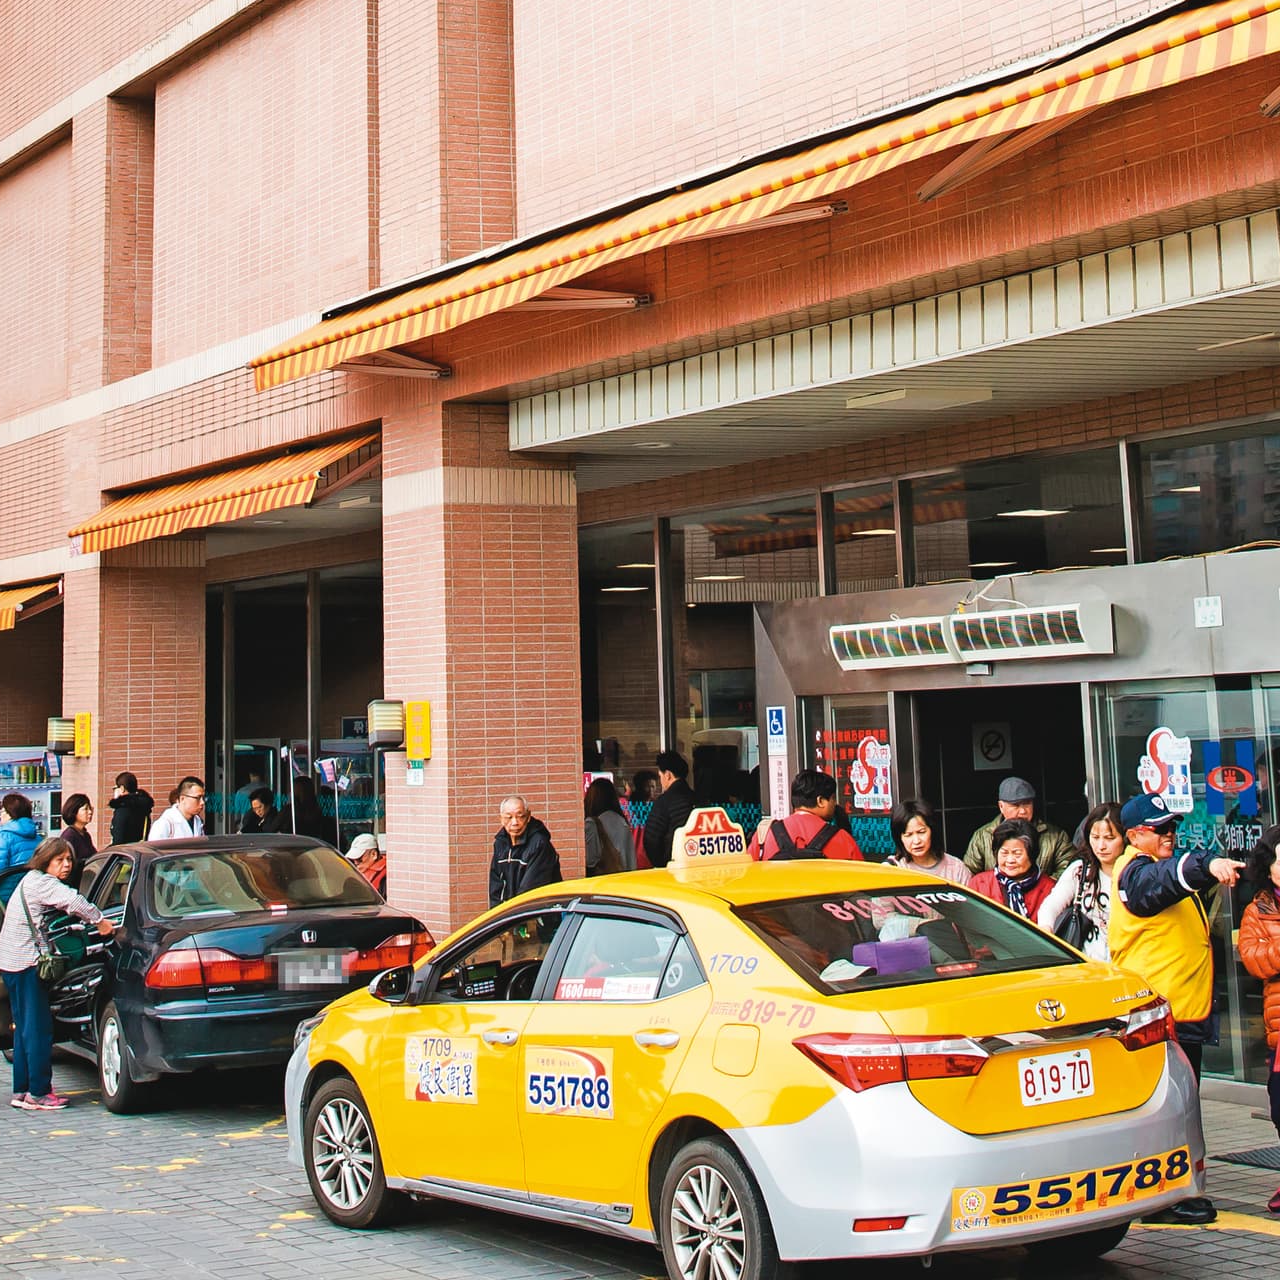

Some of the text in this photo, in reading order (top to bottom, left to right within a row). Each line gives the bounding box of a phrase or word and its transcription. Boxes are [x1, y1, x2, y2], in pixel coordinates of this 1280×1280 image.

[698, 834, 744, 856] 551788
[822, 891, 968, 922] 819-7D 1709
[708, 953, 759, 976] 1709
[560, 983, 584, 1000] 1600
[738, 998, 816, 1030] 819-7D
[422, 1038, 452, 1057] 1709
[419, 1060, 474, 1097] 優良衛星
[528, 1074, 612, 1110] 551788
[991, 1149, 1190, 1217] 551788
